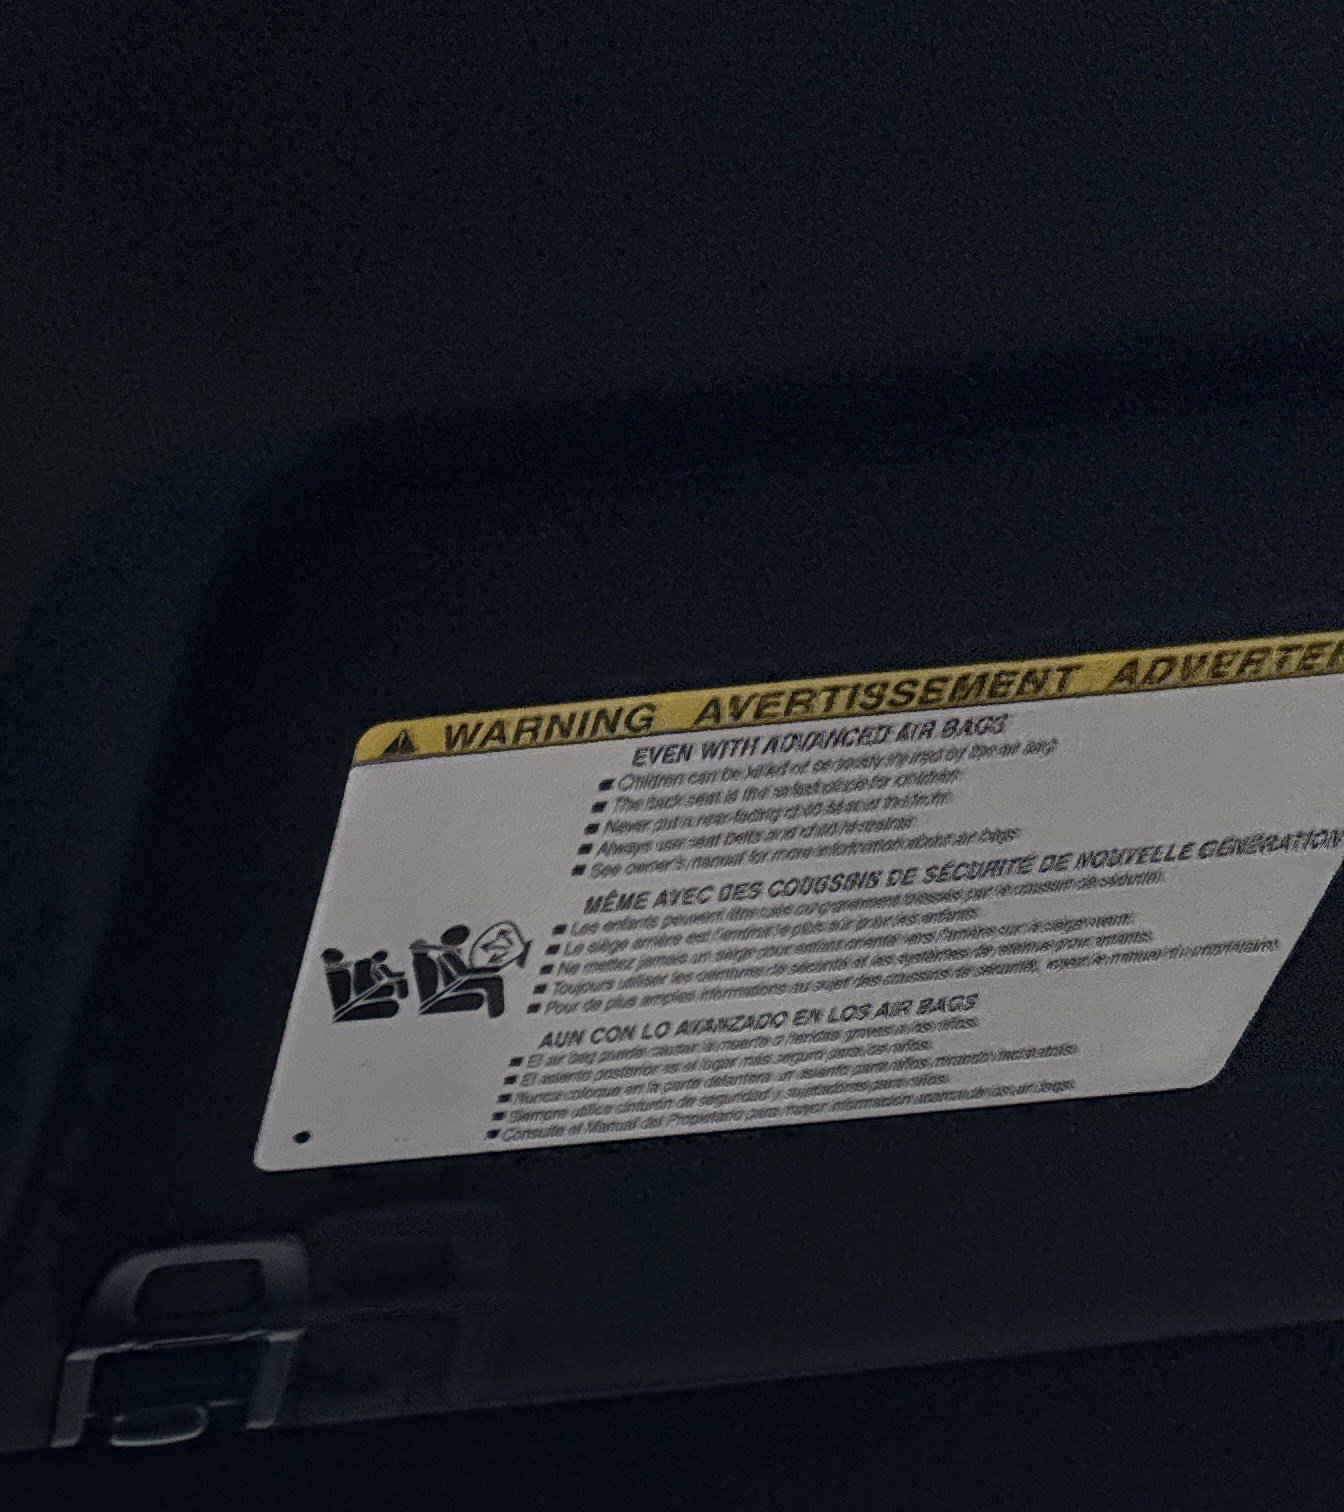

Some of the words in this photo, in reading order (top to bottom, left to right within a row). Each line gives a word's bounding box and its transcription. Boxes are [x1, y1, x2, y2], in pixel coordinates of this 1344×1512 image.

[444, 702, 659, 752] WARNING
[692, 664, 1085, 726] AVERTISSEMENT
[630, 743, 694, 766] EVEN
[698, 737, 757, 760] WITH
[761, 725, 892, 754] ADVANCED
[894, 721, 936, 742] AIR
[939, 714, 1008, 738] BAGS
[582, 886, 652, 914] MÊME
[653, 885, 715, 907] AVEC
[716, 881, 763, 901] DES
[885, 866, 919, 886] DE
[922, 851, 1037, 883] SÉCURITÉ
[1037, 852, 1073, 872] DE
[1073, 841, 1195, 869] NOUVELLE
[537, 1028, 586, 1048] AUN
[588, 1024, 639, 1044] CON
[639, 1021, 673, 1039] LO
[673, 1010, 789, 1036] AVANZADO
[790, 1007, 825, 1026] EN
[826, 1002, 872, 1022] LOS
[872, 999, 914, 1018] AIR
[915, 992, 982, 1014] BAGS
